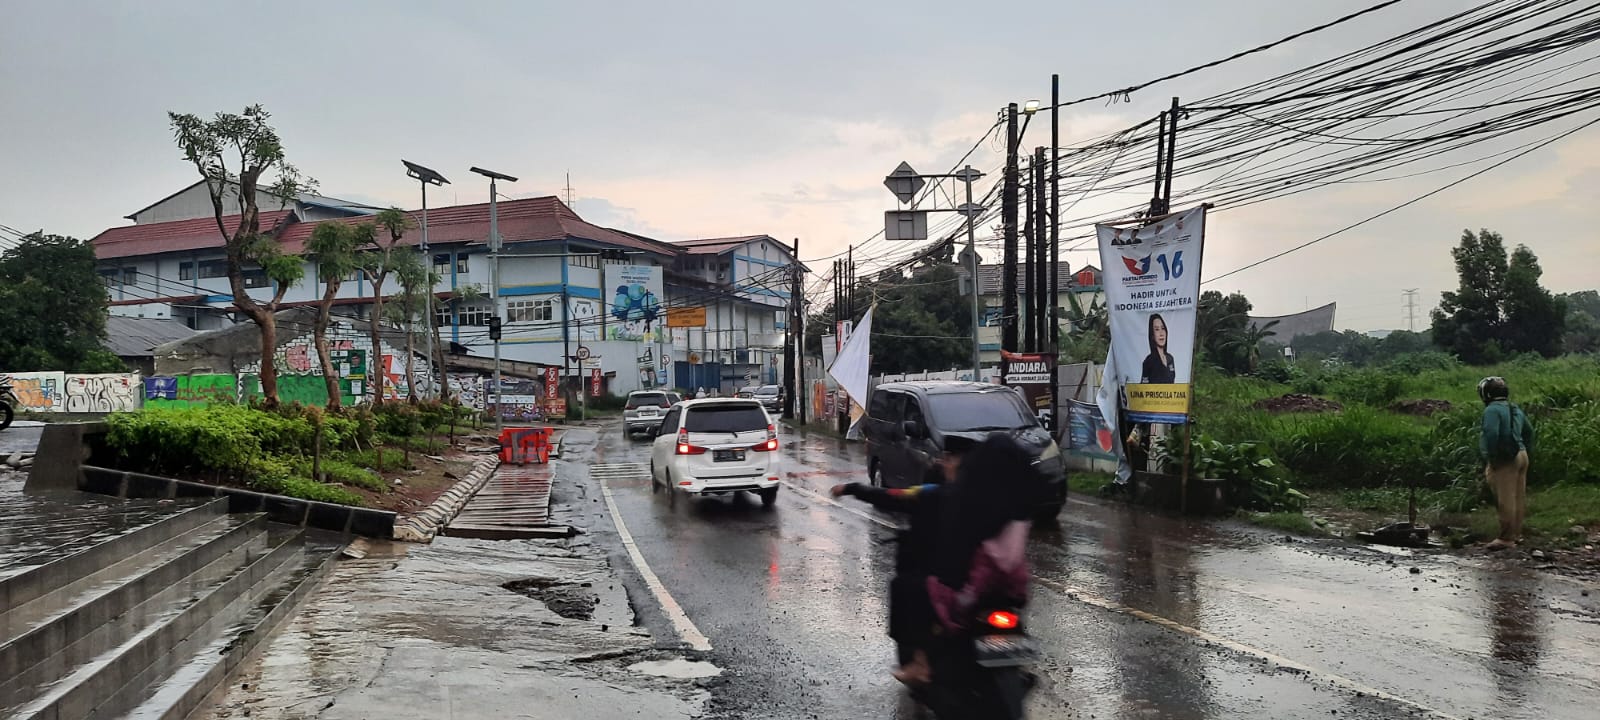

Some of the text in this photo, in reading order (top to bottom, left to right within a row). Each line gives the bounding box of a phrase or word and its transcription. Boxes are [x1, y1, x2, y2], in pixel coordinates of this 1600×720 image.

[1156, 251, 1184, 281] 16
[1130, 290, 1155, 300] HADIR
[1008, 362, 1047, 373] ANDIARA
